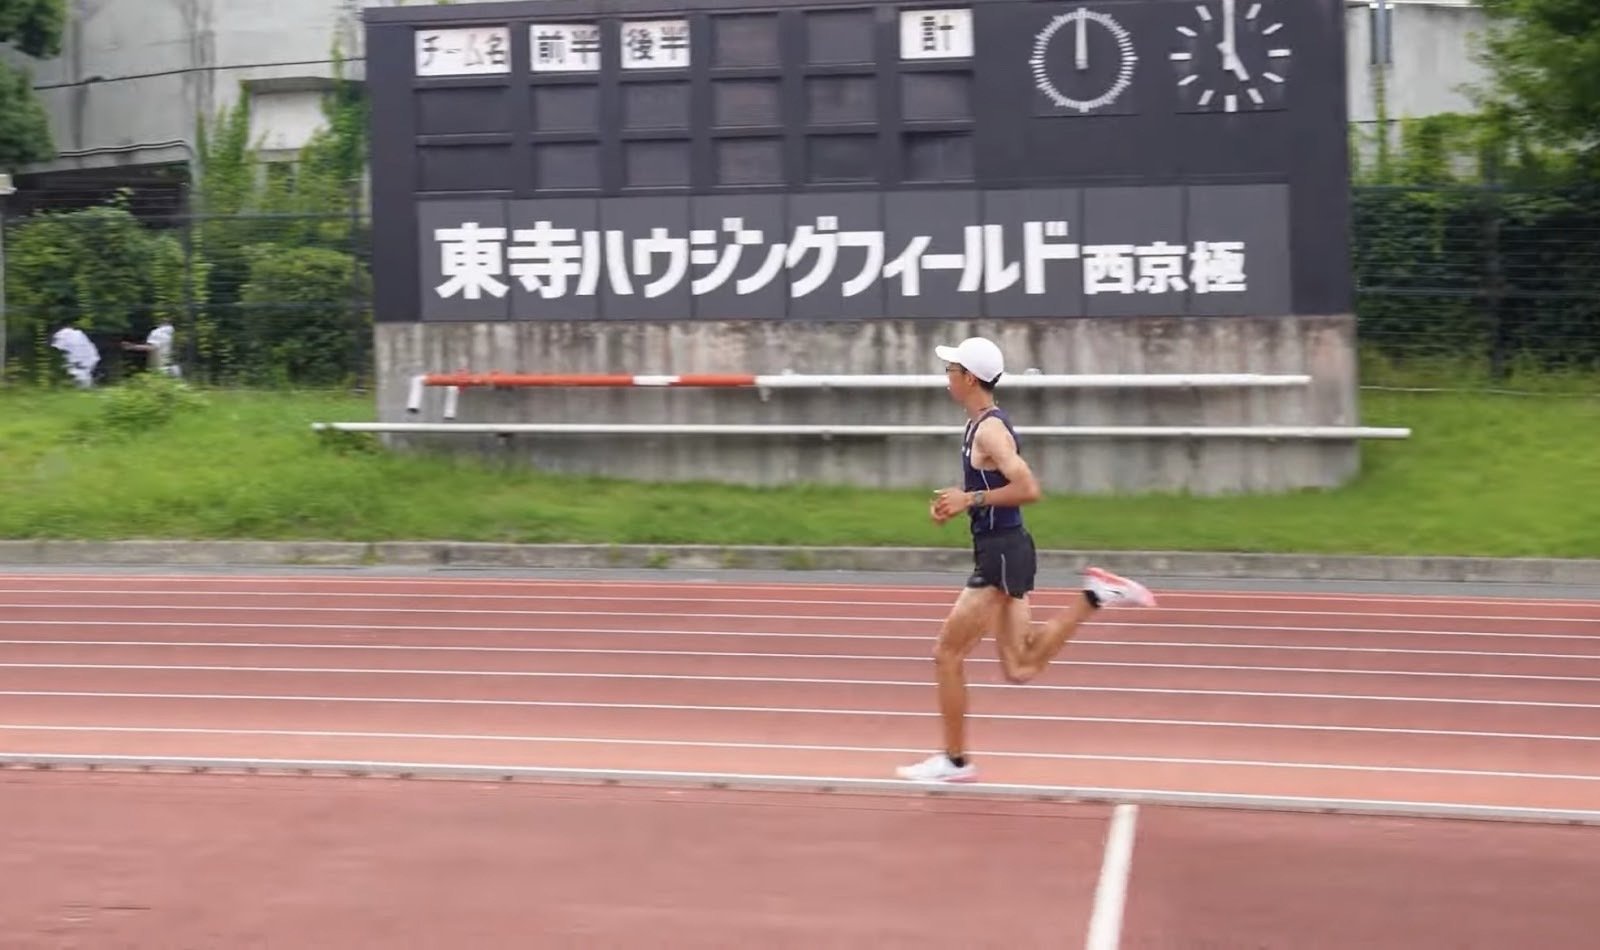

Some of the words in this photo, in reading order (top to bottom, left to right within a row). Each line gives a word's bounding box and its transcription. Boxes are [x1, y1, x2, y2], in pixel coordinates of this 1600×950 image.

[537, 30, 600, 64] 前半
[626, 27, 690, 61] 後半
[921, 15, 954, 51] 計
[422, 34, 508, 67] チーム名
[434, 215, 1247, 299] 東寺ハウジングフィールド西京極
